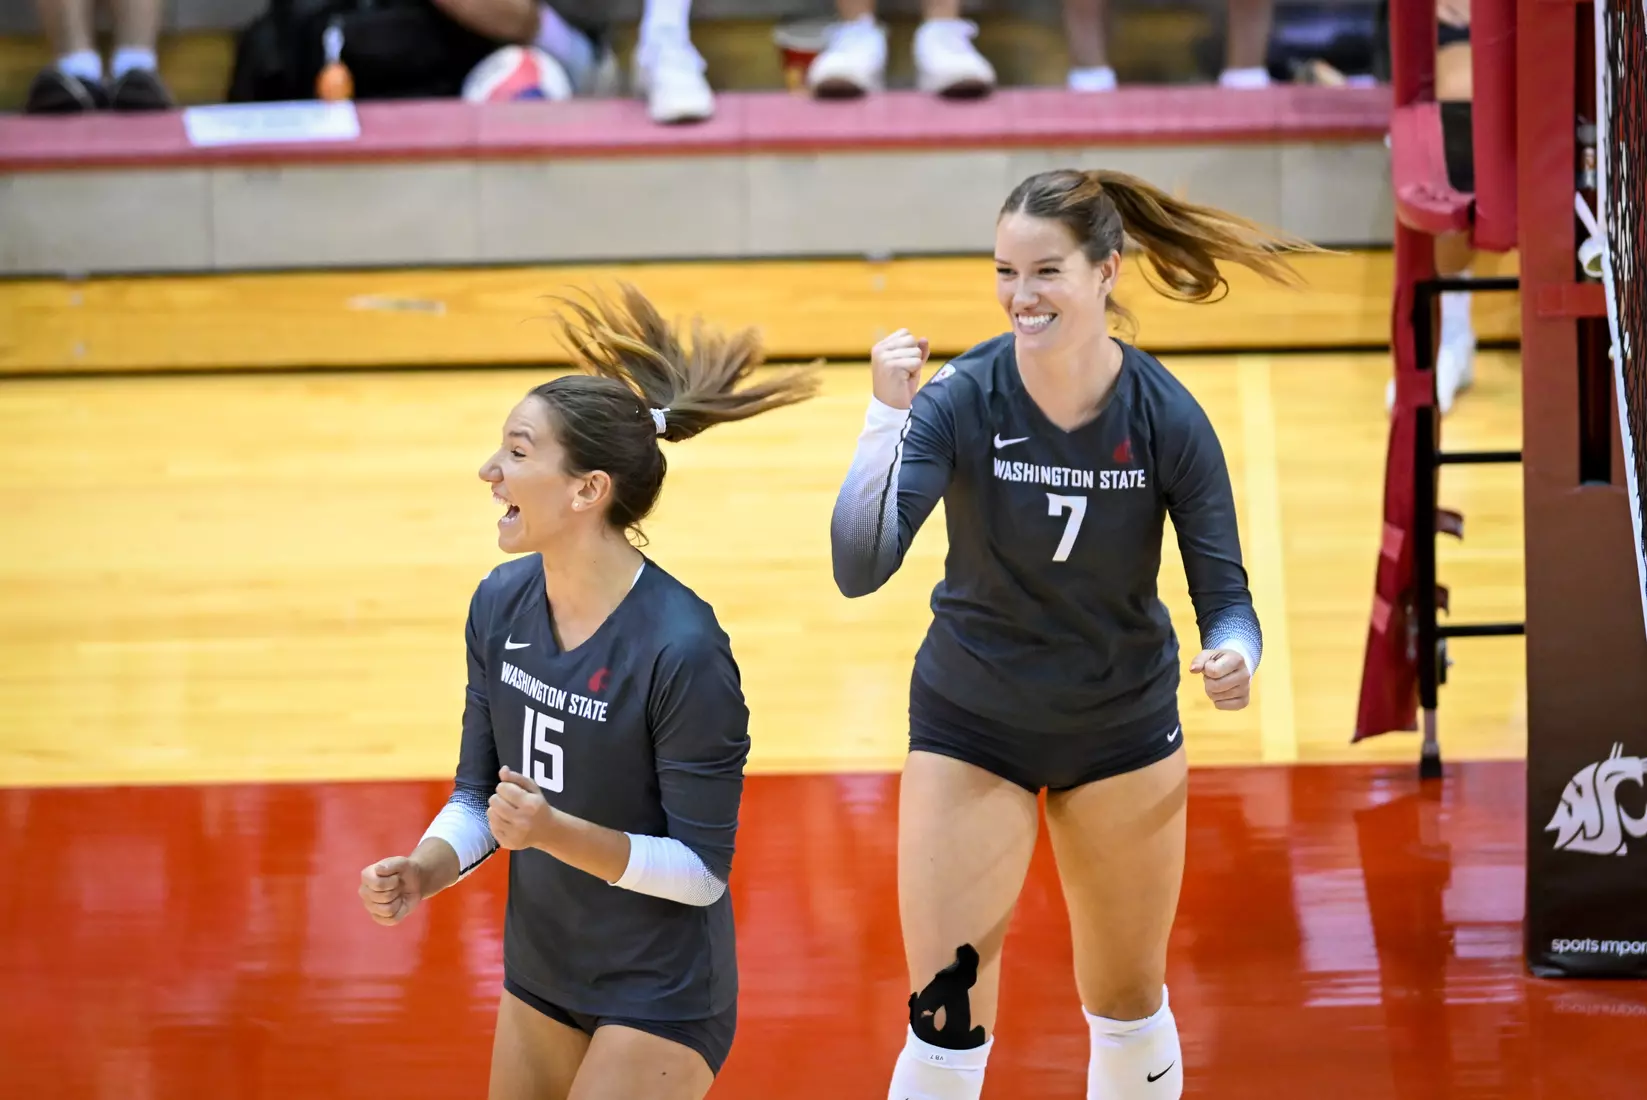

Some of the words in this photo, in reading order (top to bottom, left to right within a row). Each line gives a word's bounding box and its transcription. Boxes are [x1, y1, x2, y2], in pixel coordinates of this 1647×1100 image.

[993, 457, 1094, 489] WASHINGTON
[1099, 469, 1146, 489] STATE
[1045, 492, 1087, 562] 7
[501, 661, 567, 711] WASHINGTON
[568, 693, 608, 722] STATE
[522, 705, 565, 793] 15
[1551, 937, 1599, 954] sports
